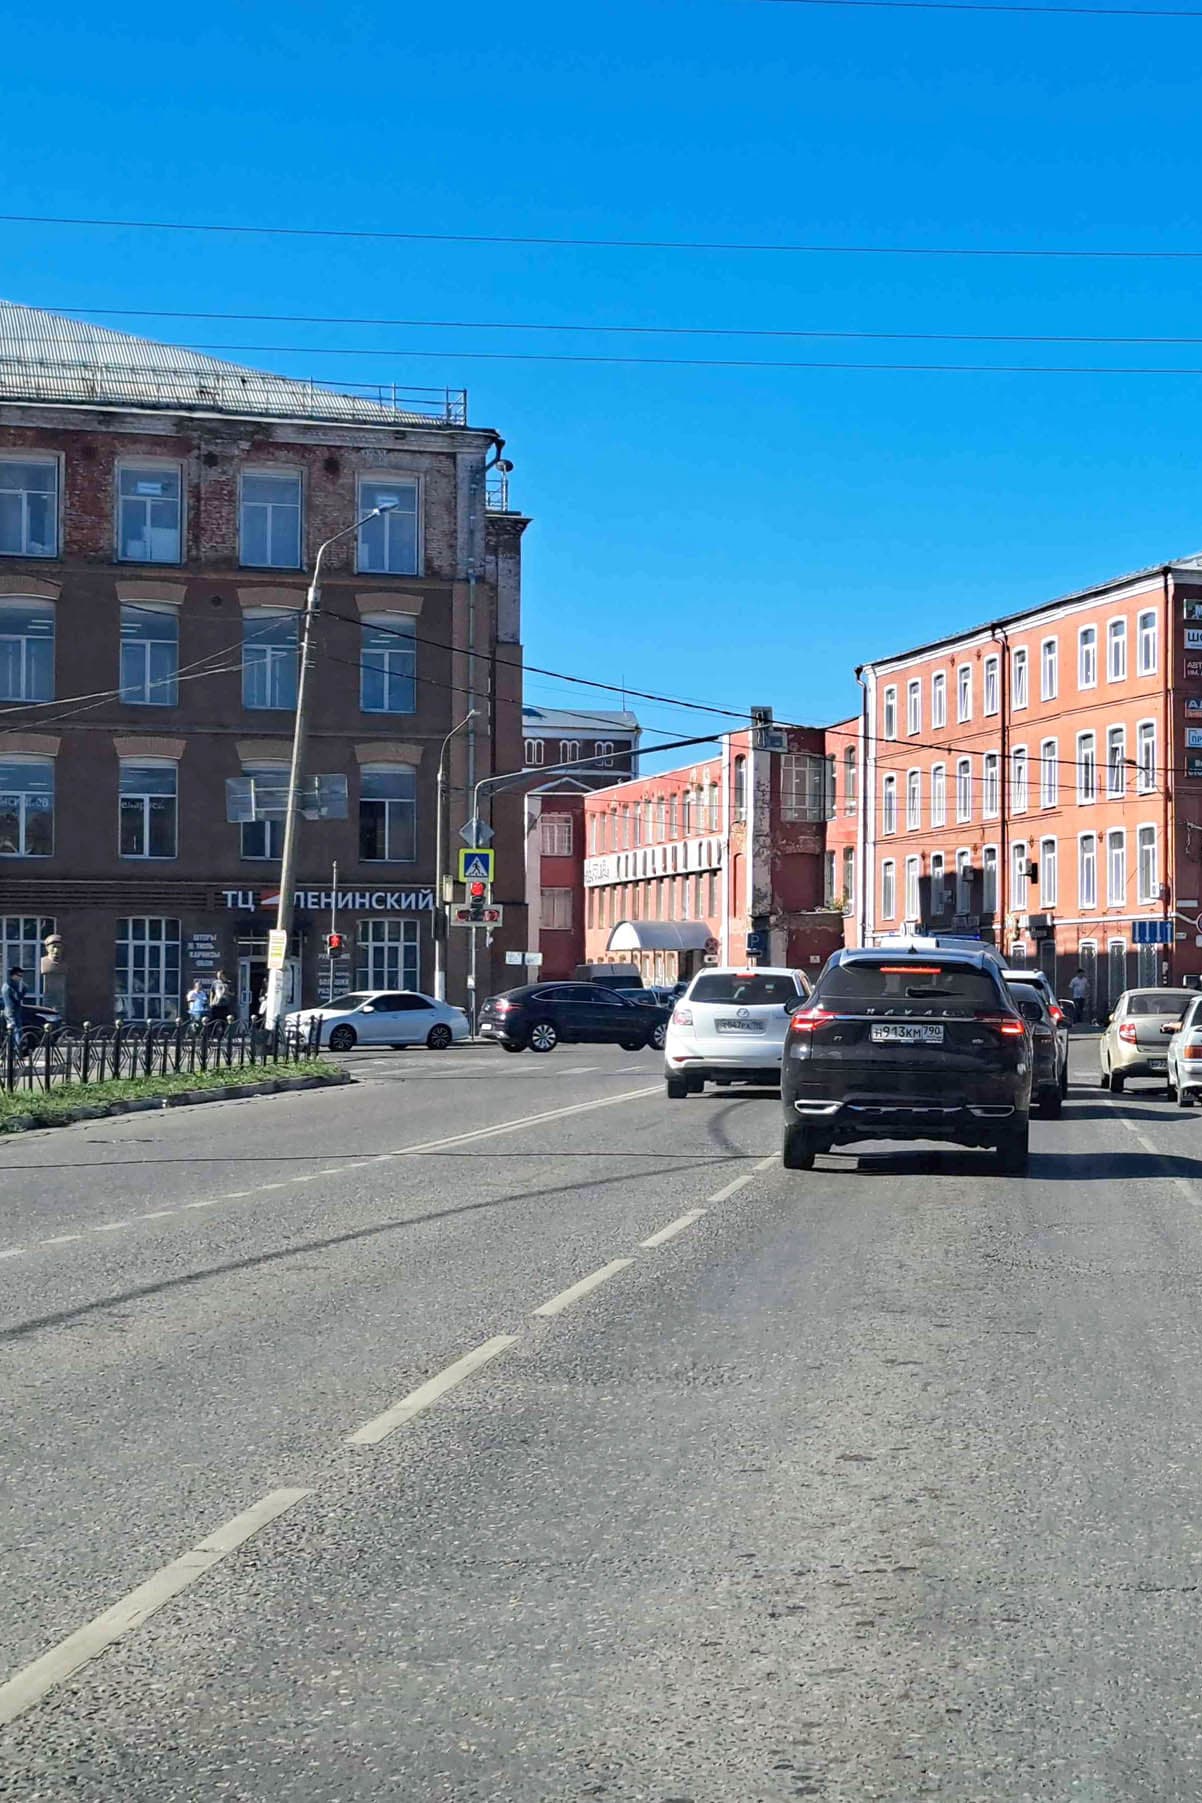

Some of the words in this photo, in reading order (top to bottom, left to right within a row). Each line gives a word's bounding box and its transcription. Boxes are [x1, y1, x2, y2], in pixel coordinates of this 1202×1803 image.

[221, 890, 255, 912] ТЦ
[293, 888, 434, 910] ЛЕНИНСКИЙ
[865, 1008, 950, 1016] HAVAL
